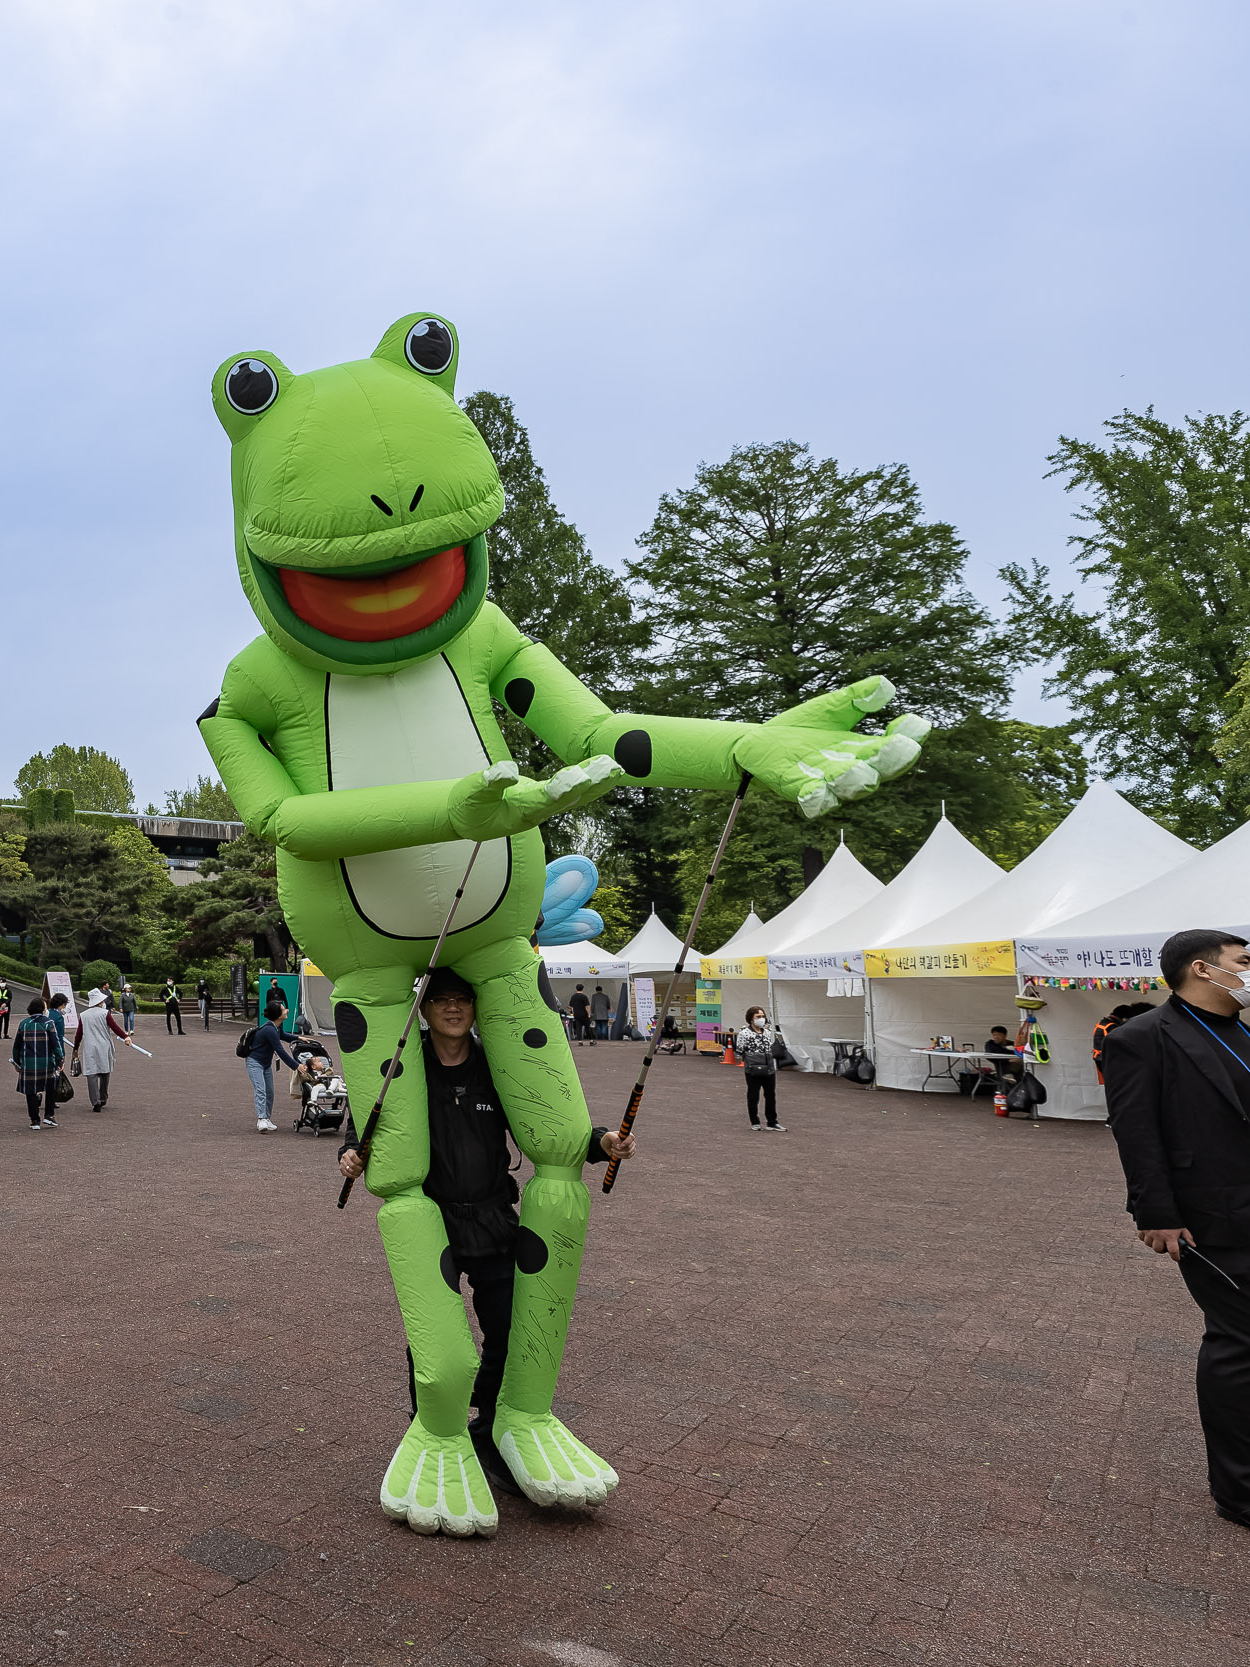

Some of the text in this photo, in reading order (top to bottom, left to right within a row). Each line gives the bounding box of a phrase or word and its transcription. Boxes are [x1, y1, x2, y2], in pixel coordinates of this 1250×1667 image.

[895, 956, 917, 970] 나만의
[943, 953, 967, 969] 만들기
[1076, 950, 1091, 968] 야!
[1094, 949, 1116, 968] 나도
[1119, 947, 1153, 968] 뜨개할
[476, 1103, 494, 1112] STA
